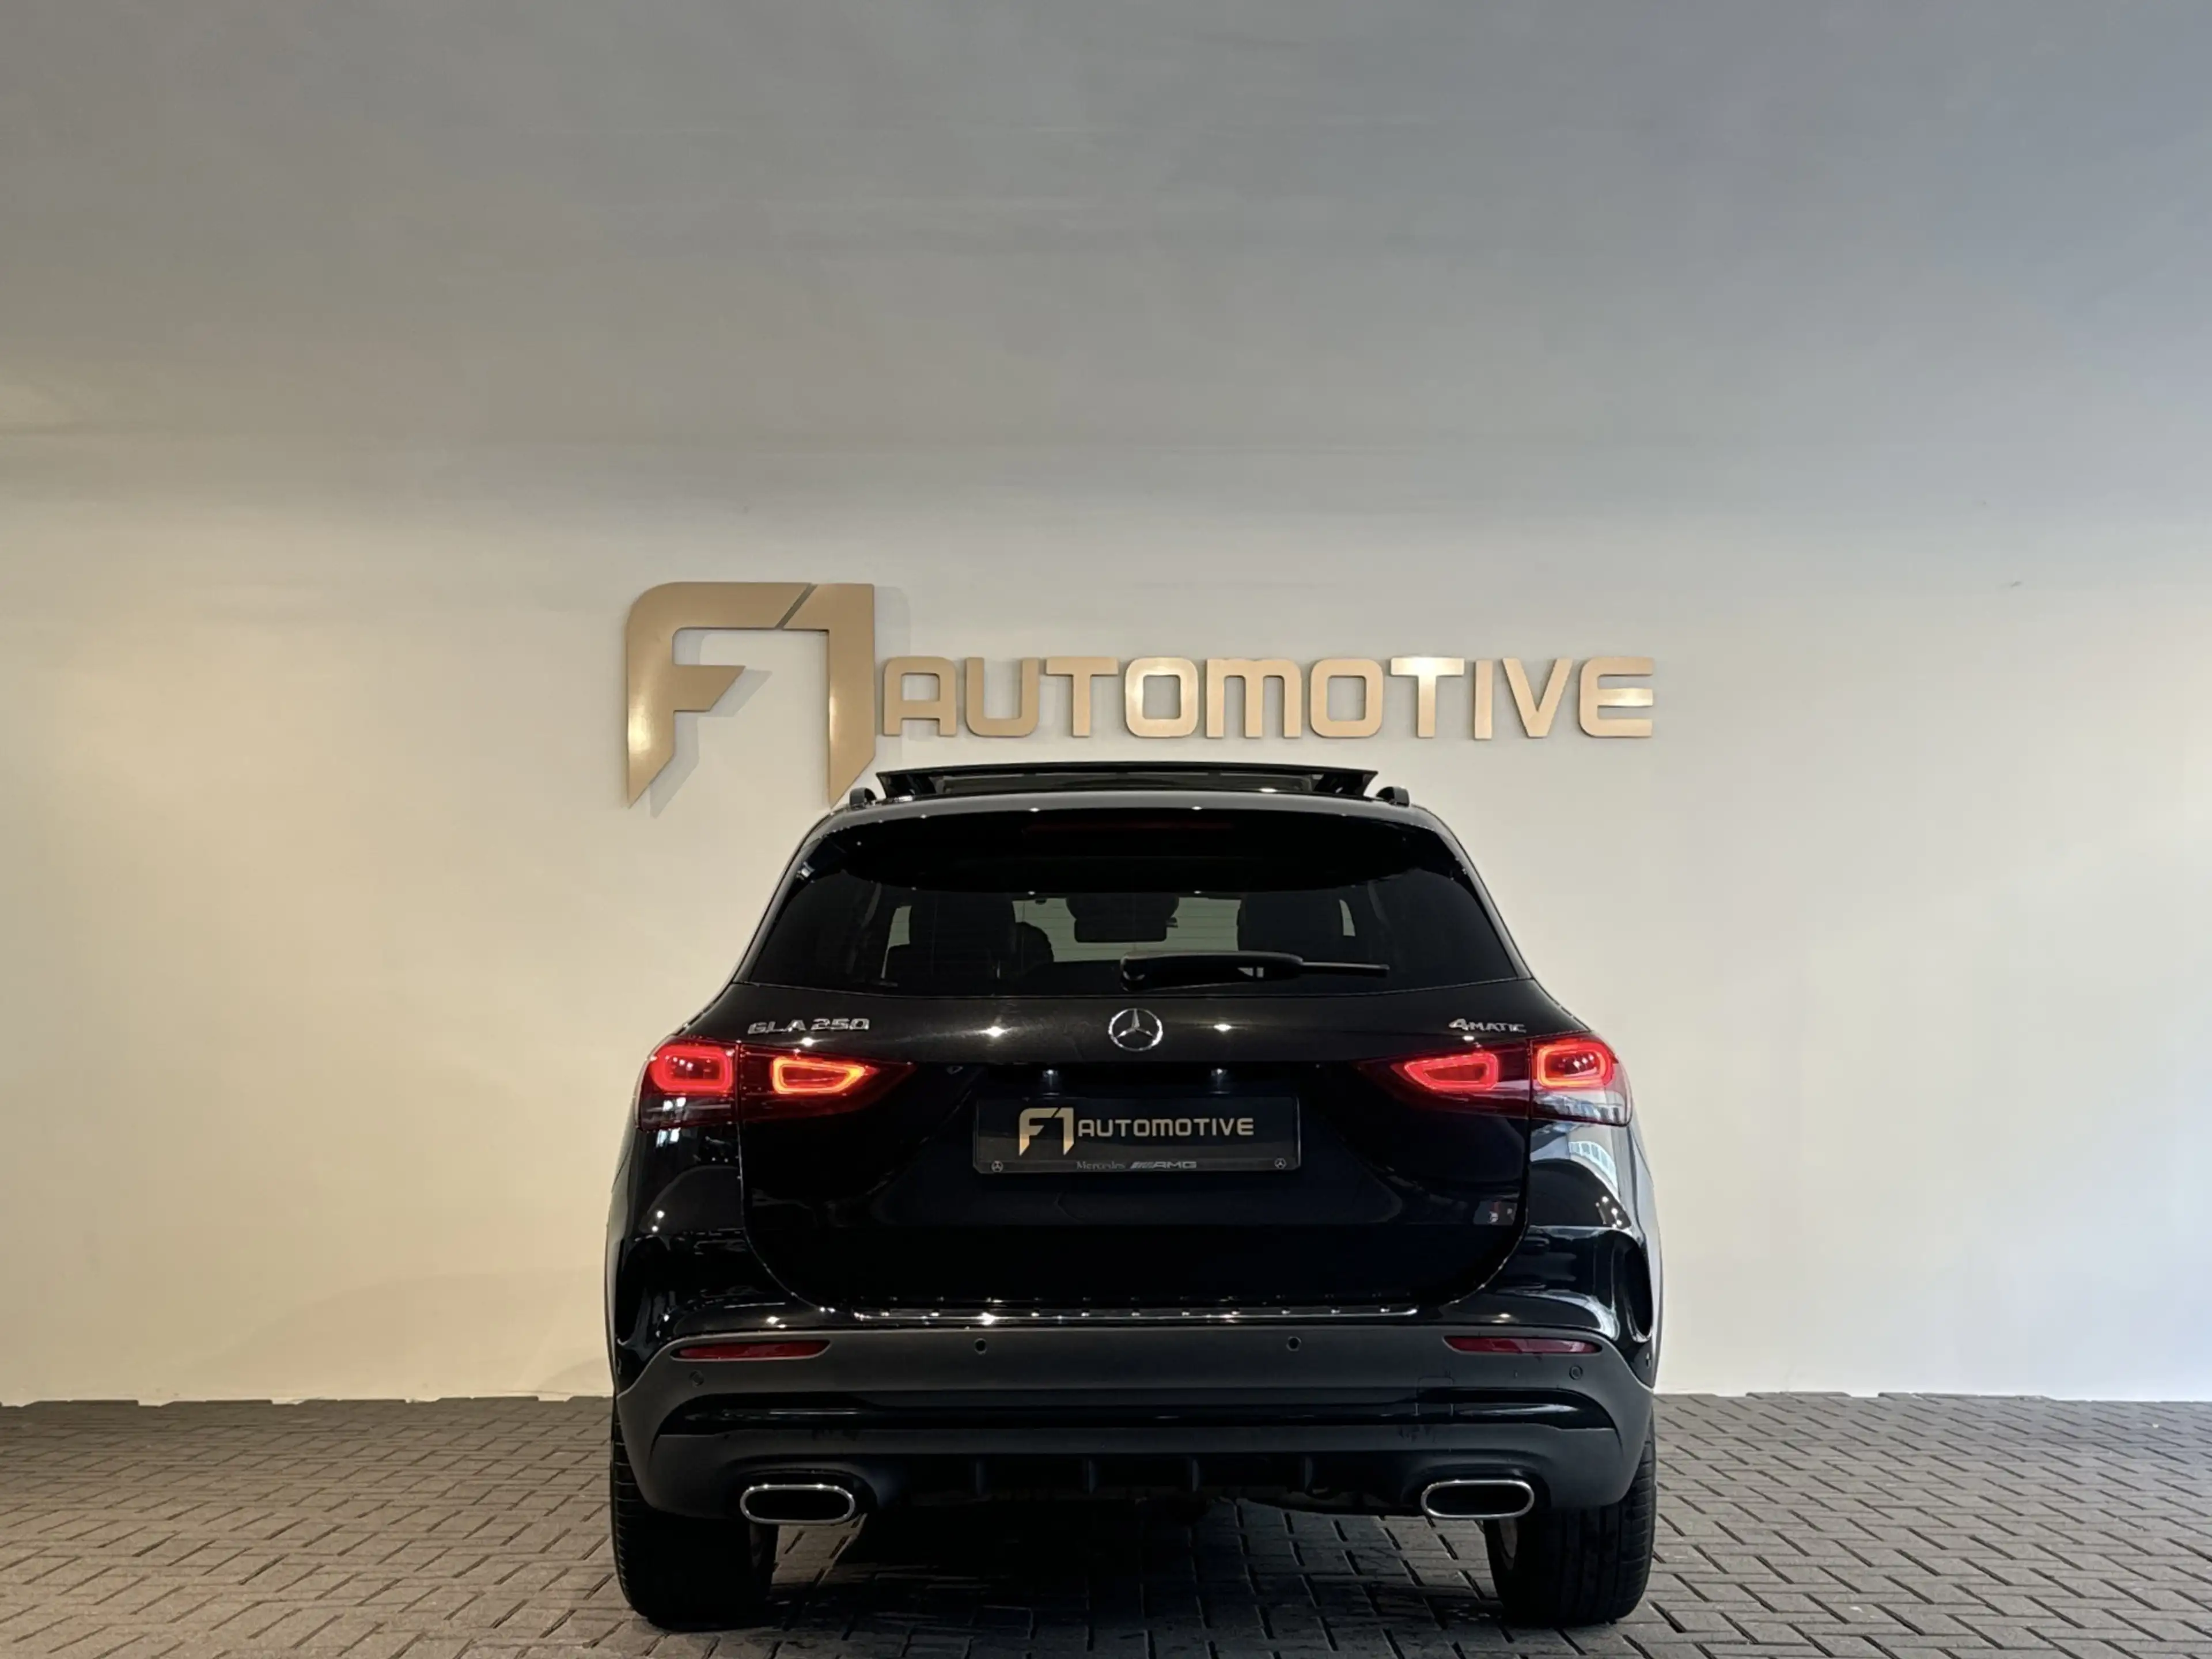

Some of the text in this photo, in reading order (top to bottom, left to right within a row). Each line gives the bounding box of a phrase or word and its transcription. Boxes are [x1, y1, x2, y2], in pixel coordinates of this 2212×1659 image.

[626, 582, 1653, 809] F1 AUTOMOTIVE
[748, 1018, 869, 1035] GLA 250
[1448, 1018, 1527, 1033] 4MATIC
[1018, 1107, 1255, 1156] F1 AUTOMOTIVE
[1076, 1161, 1197, 1170] Mercedes AMG
